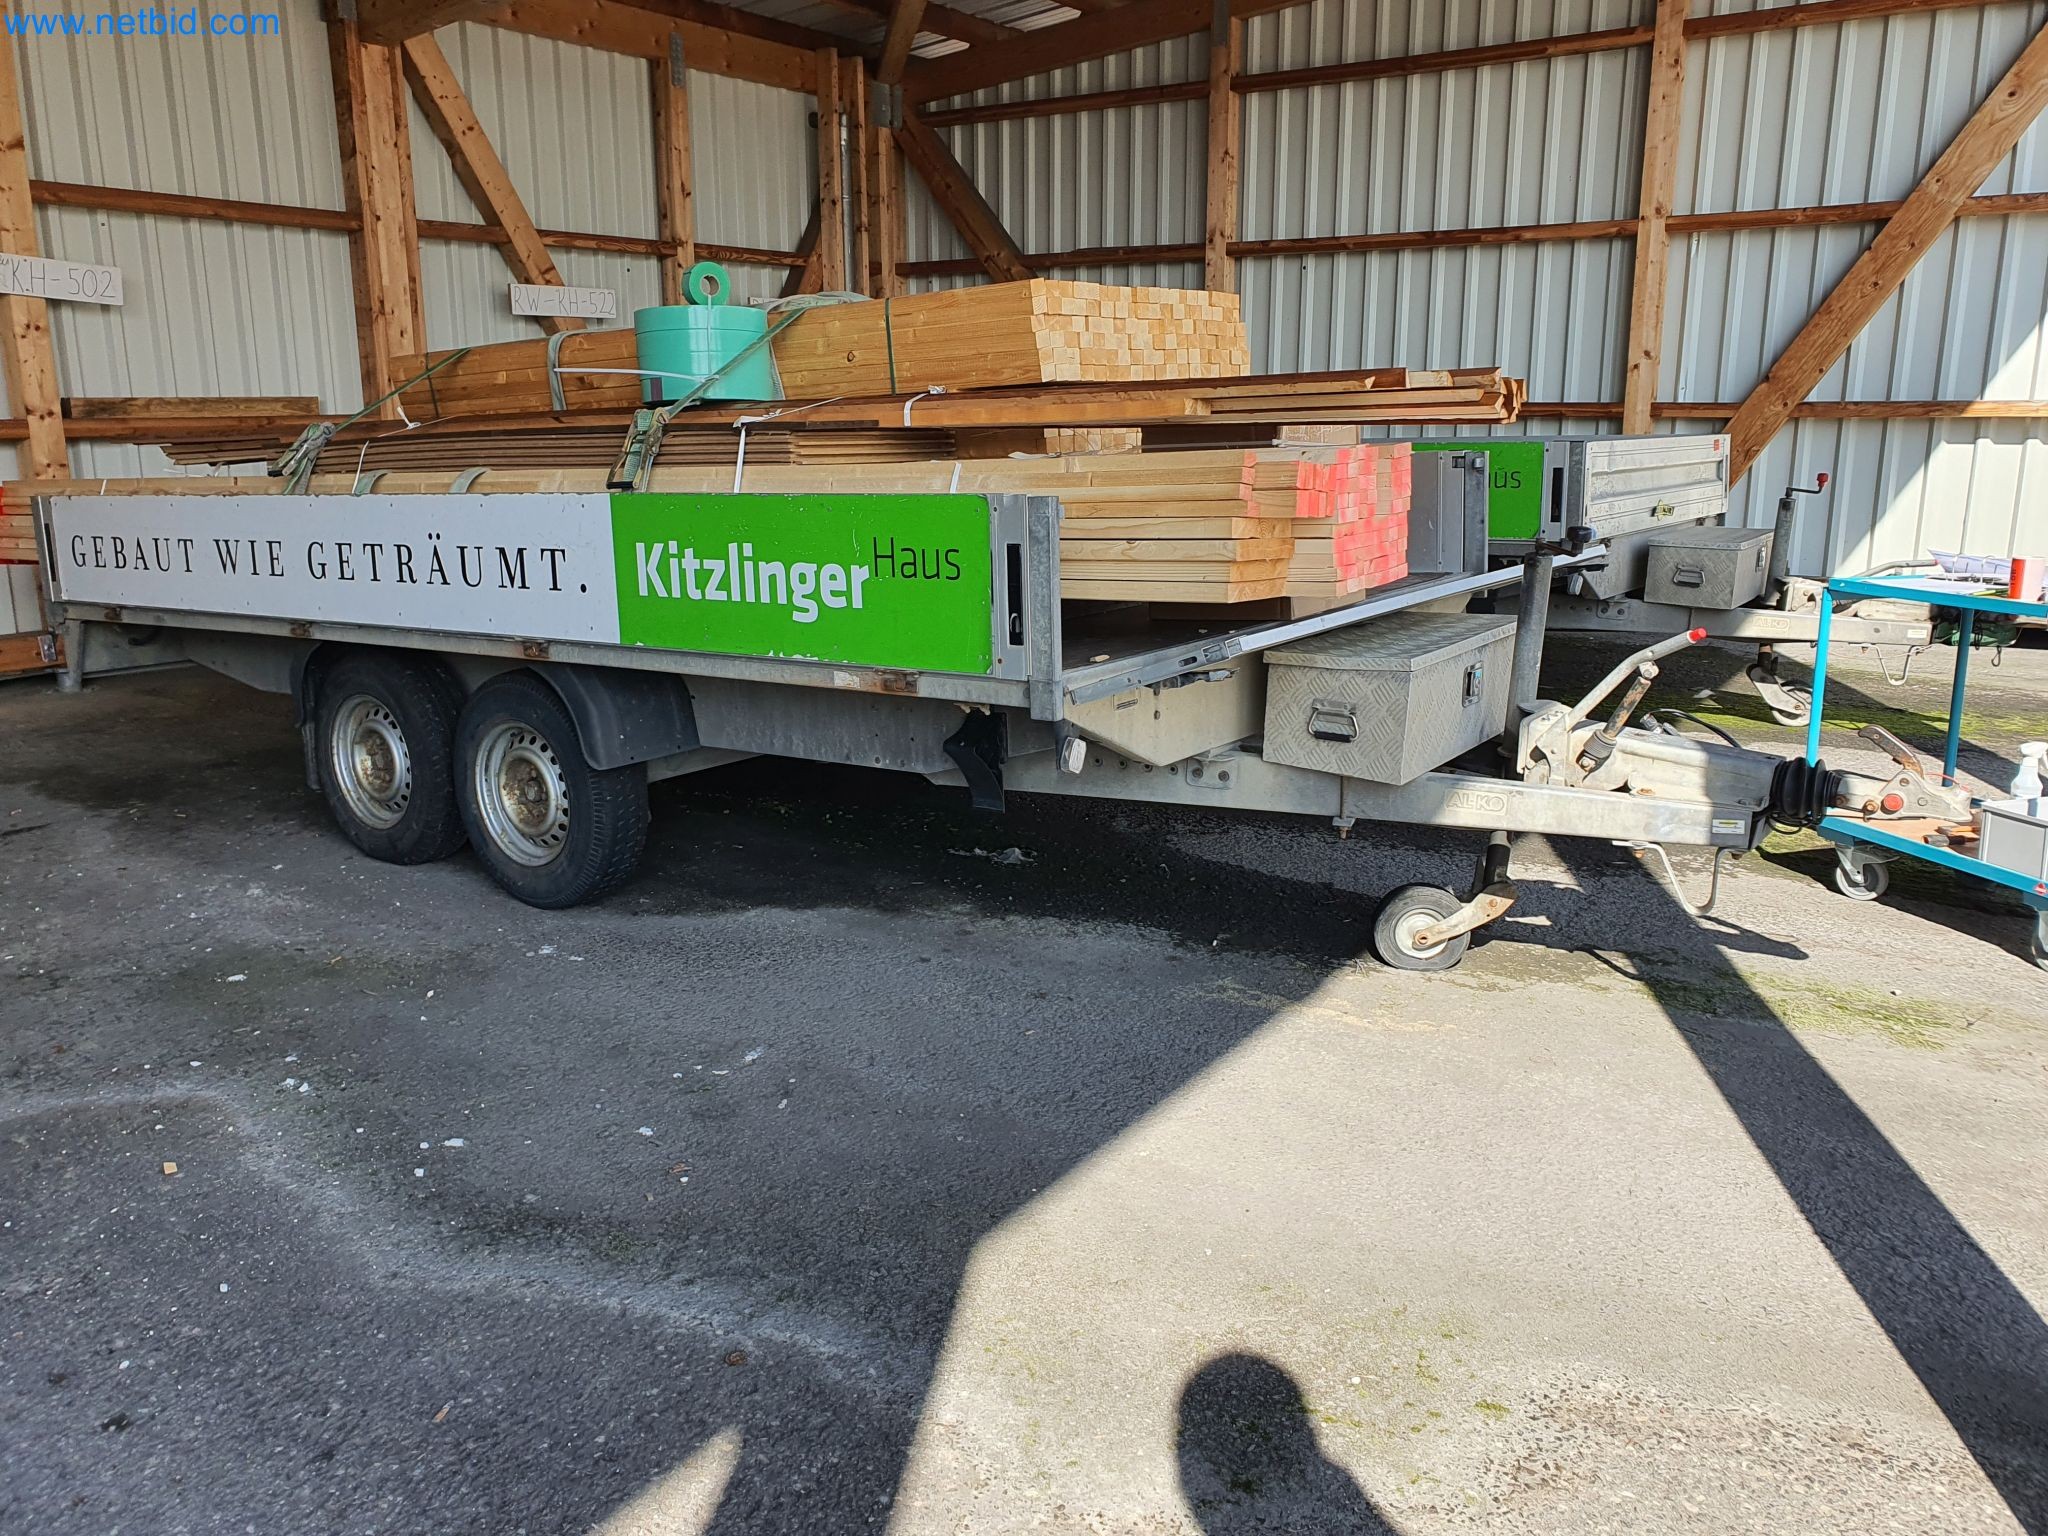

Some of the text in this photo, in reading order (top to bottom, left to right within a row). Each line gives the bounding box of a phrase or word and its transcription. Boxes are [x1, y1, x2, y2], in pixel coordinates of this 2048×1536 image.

[514, 286, 615, 315] RW-KH-522
[1488, 470, 1522, 489] us
[71, 533, 588, 594] GEBAUT WIE GETRÄUMT.
[873, 536, 961, 581] Haus
[635, 540, 870, 624] Kitzlinger
[1446, 790, 1506, 812] AL-KO
